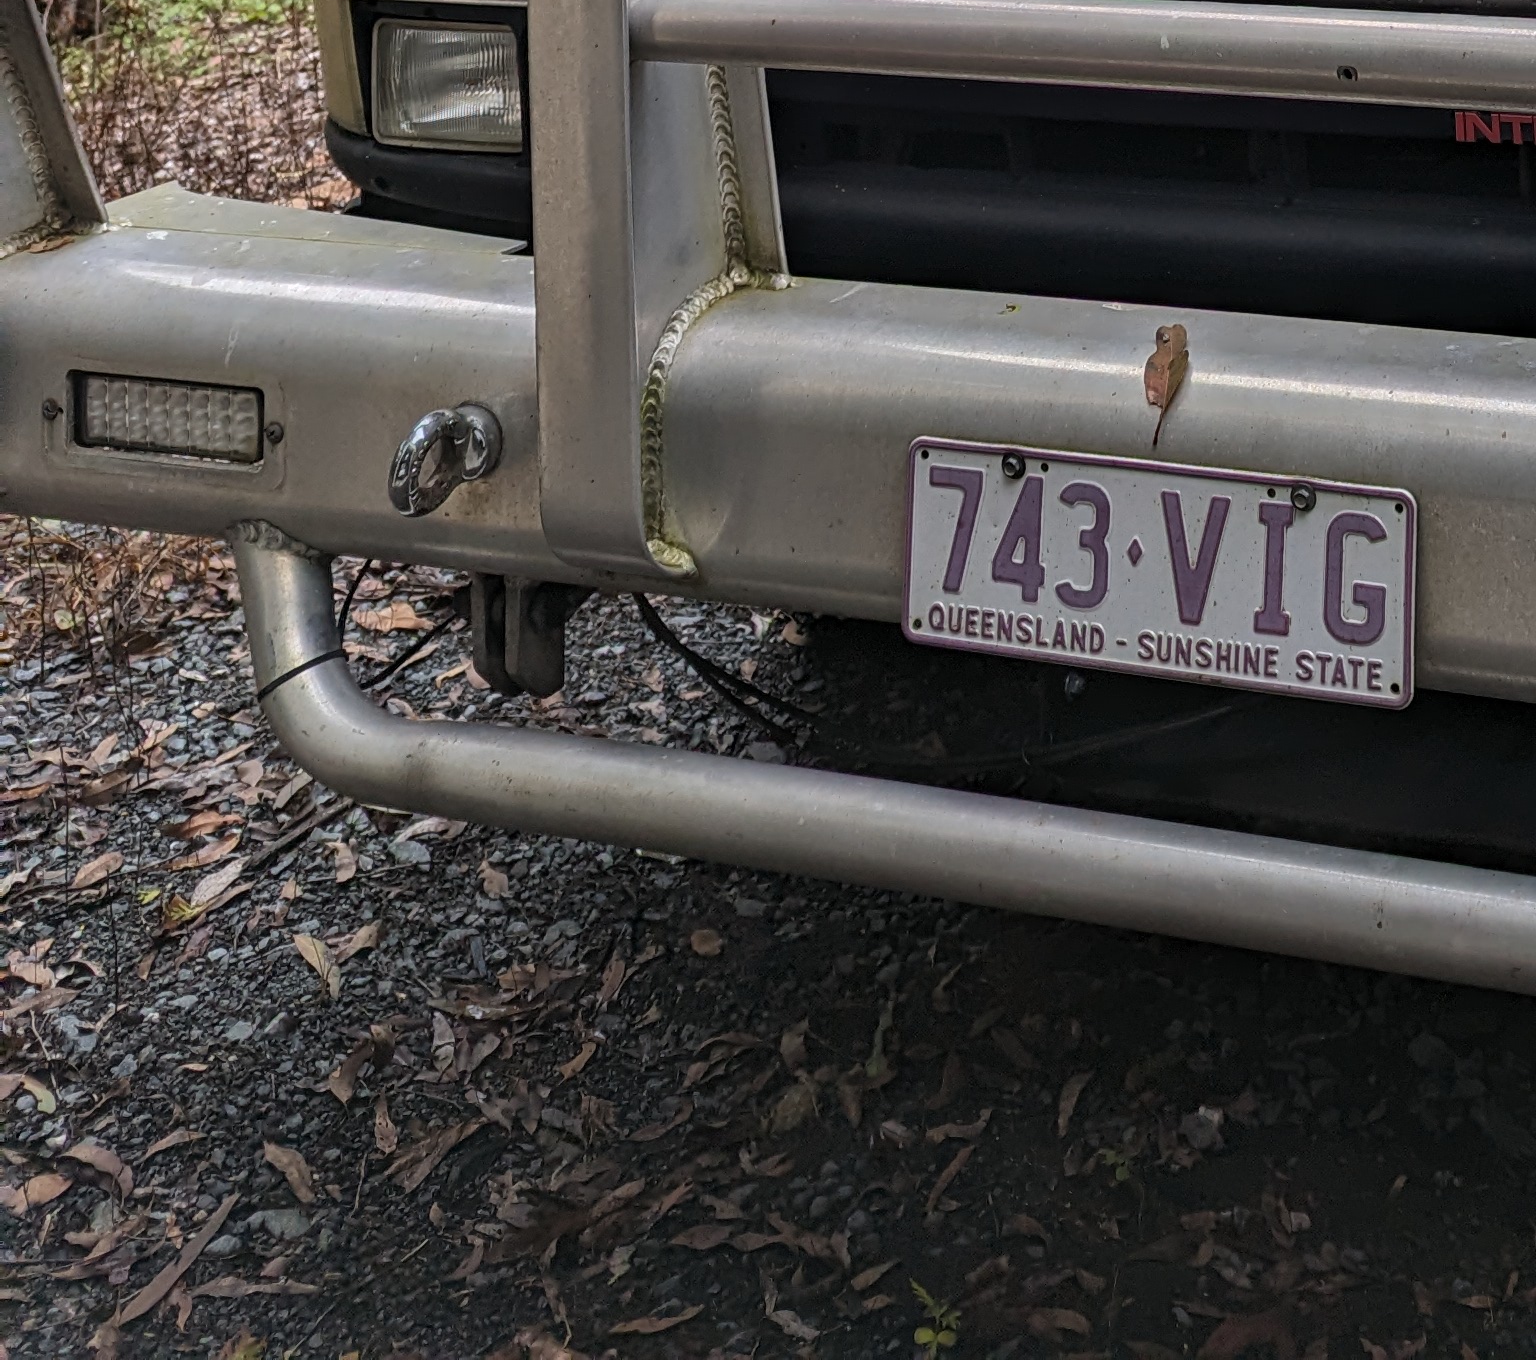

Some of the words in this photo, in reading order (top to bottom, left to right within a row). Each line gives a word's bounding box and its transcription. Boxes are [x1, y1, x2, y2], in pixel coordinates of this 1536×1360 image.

[927, 601, 1106, 654] QUEENSLAND
[1136, 629, 1280, 679] SUNSHINE
[1295, 649, 1385, 692] STATE
